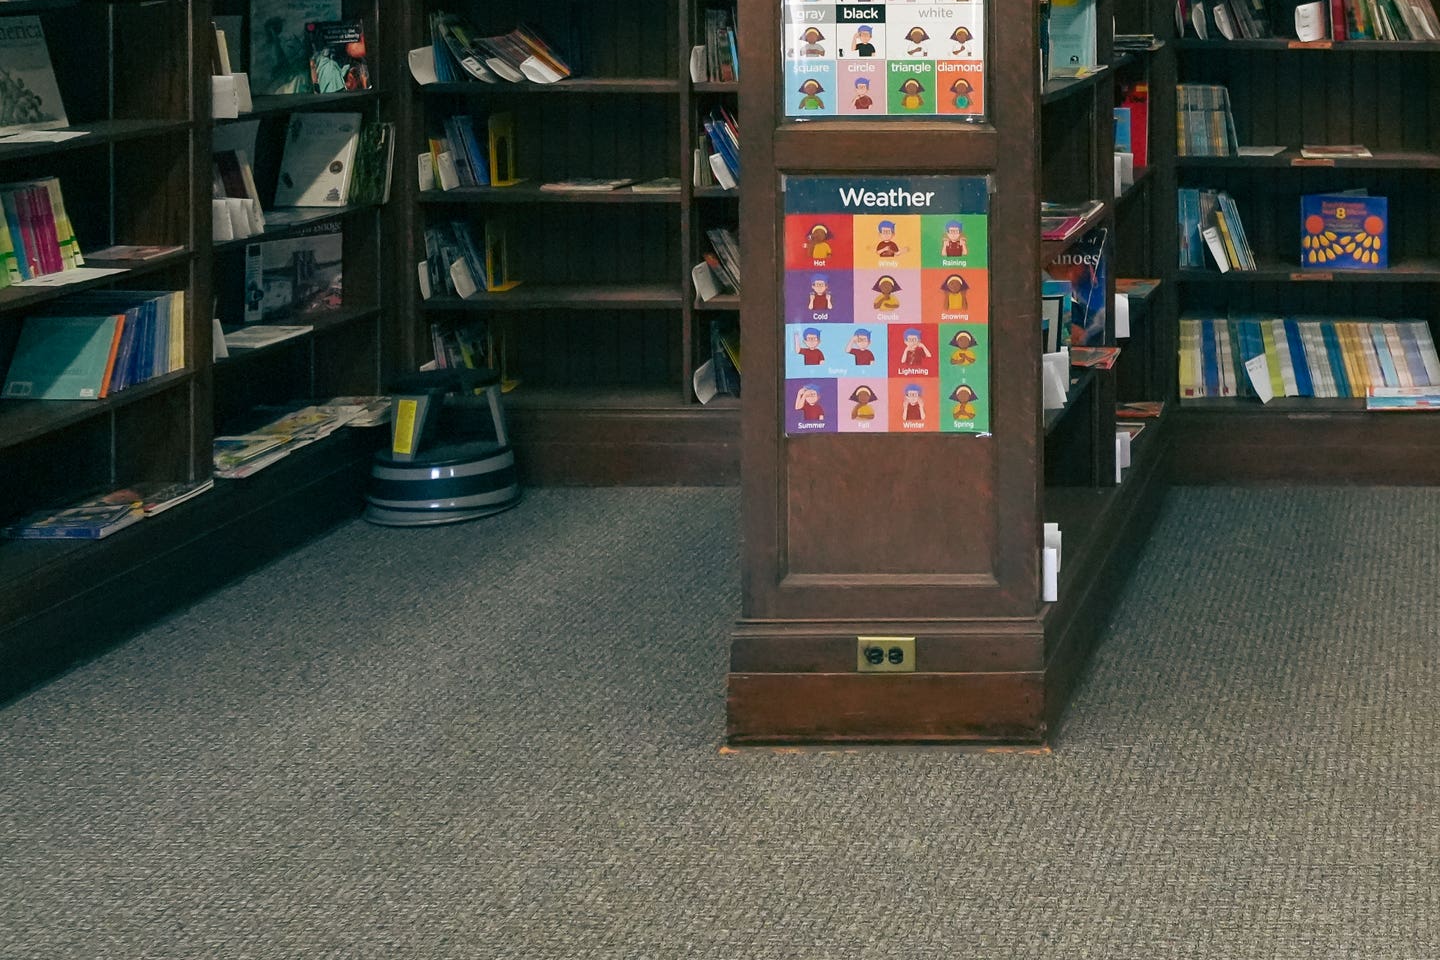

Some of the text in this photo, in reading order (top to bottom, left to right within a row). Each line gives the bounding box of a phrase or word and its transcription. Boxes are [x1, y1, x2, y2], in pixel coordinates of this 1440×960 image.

[796, 8, 826, 21] gray
[843, 7, 878, 19] black
[918, 8, 953, 19] white
[793, 63, 829, 74] square
[847, 62, 876, 72] circle
[891, 62, 931, 74] triangle
[938, 62, 982, 73] diamond
[839, 187, 934, 208] Weather
[813, 259, 826, 267] Hot
[943, 260, 966, 268] Raining
[941, 313, 968, 321] Snowing
[898, 367, 929, 376] Lightning
[798, 422, 825, 430] Summer
[903, 421, 924, 430] Winter
[954, 421, 974, 429] Spring
